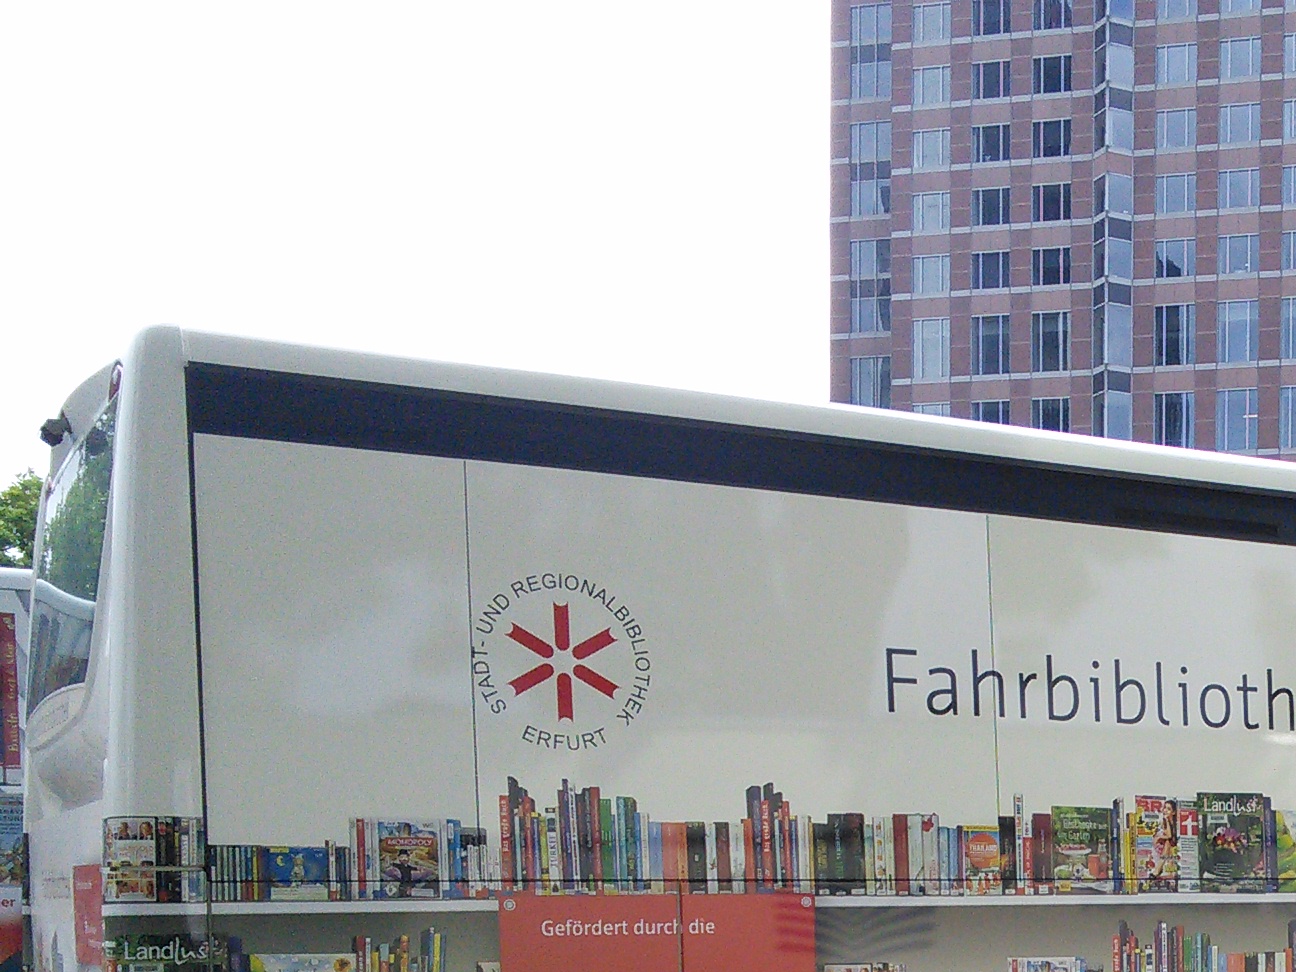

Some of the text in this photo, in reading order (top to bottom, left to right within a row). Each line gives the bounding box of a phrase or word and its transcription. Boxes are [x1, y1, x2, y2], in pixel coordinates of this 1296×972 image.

[476, 593, 510, 635] UND
[511, 573, 650, 726] REGIONALBIBLIOTHEK
[521, 725, 608, 751] ERFURT
[1203, 795, 1257, 815] Landlust
[387, 838, 433, 846] MONOPOLY
[541, 918, 716, 937] Gefördert durch die
